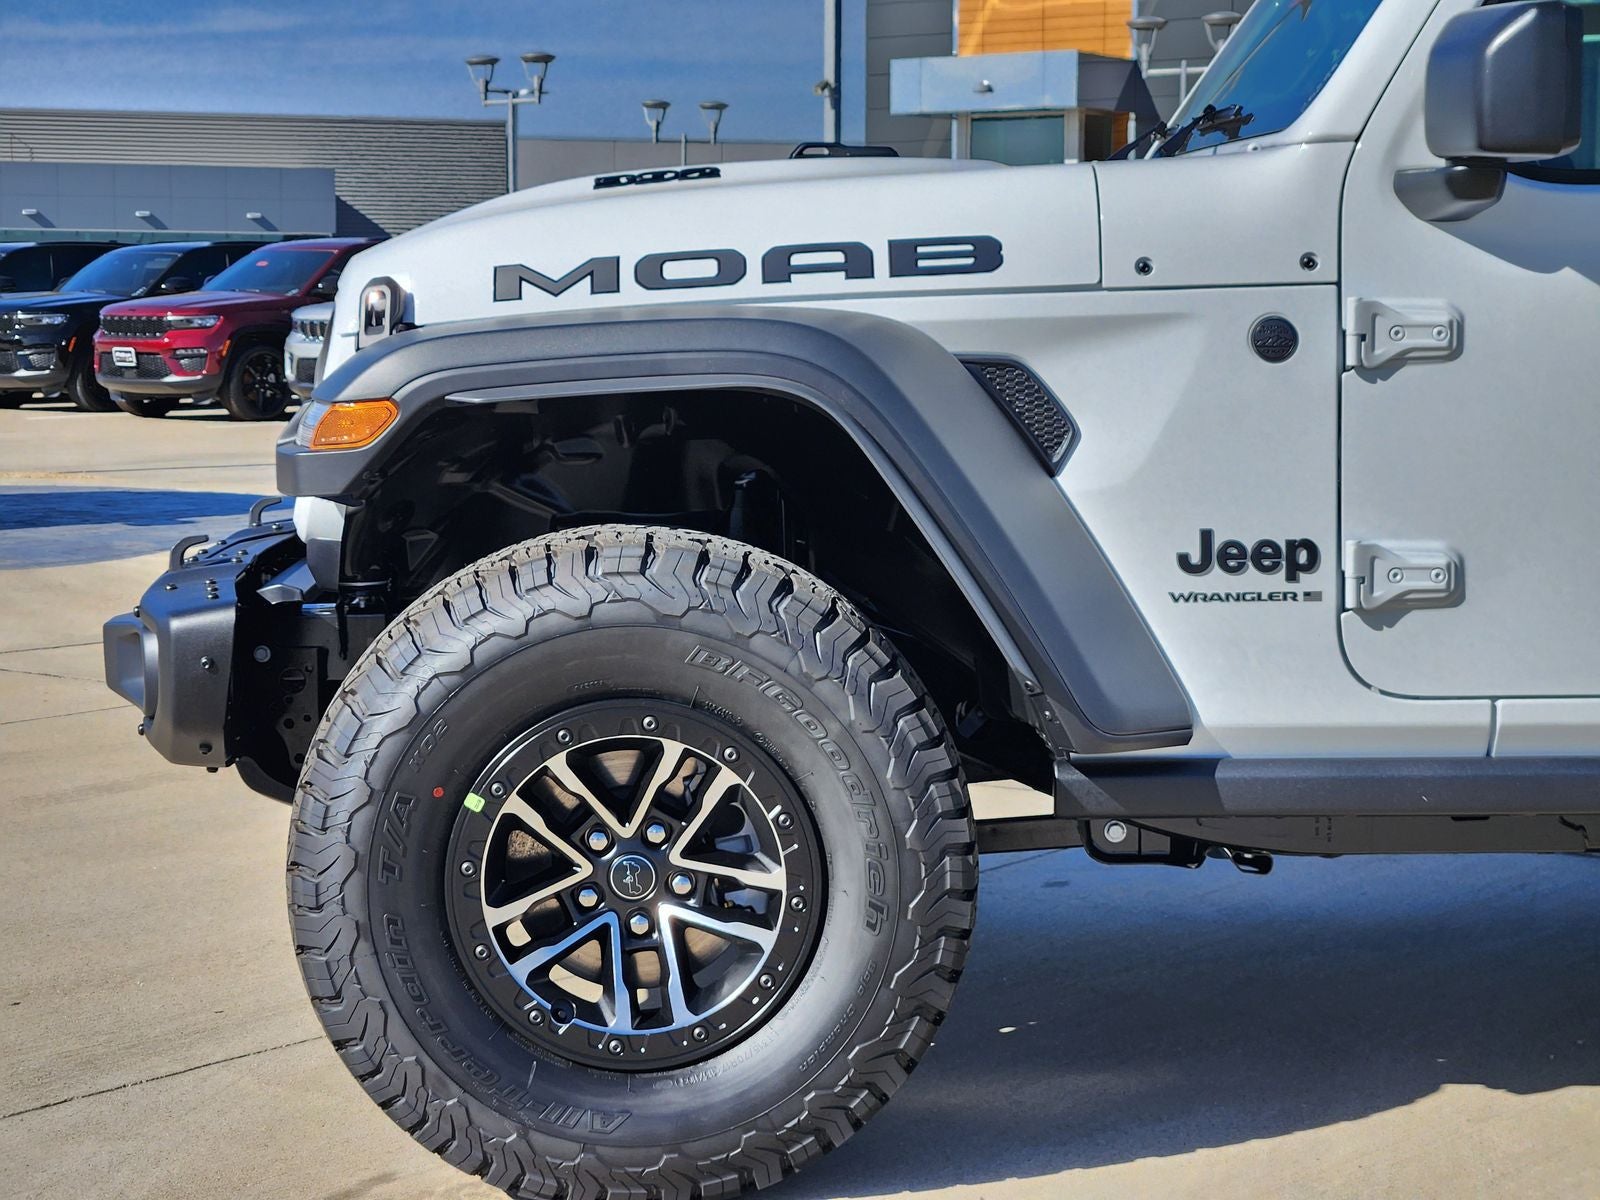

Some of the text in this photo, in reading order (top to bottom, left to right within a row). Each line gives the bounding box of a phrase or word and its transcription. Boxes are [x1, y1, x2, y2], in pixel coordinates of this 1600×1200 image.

[493, 235, 1003, 302] MOAB
[1176, 528, 1321, 583] Jeep
[1168, 591, 1299, 603] WRANGLER
[376, 790, 417, 886] T/A
[408, 718, 448, 774] KO2
[685, 645, 889, 937] BFGoodrich
